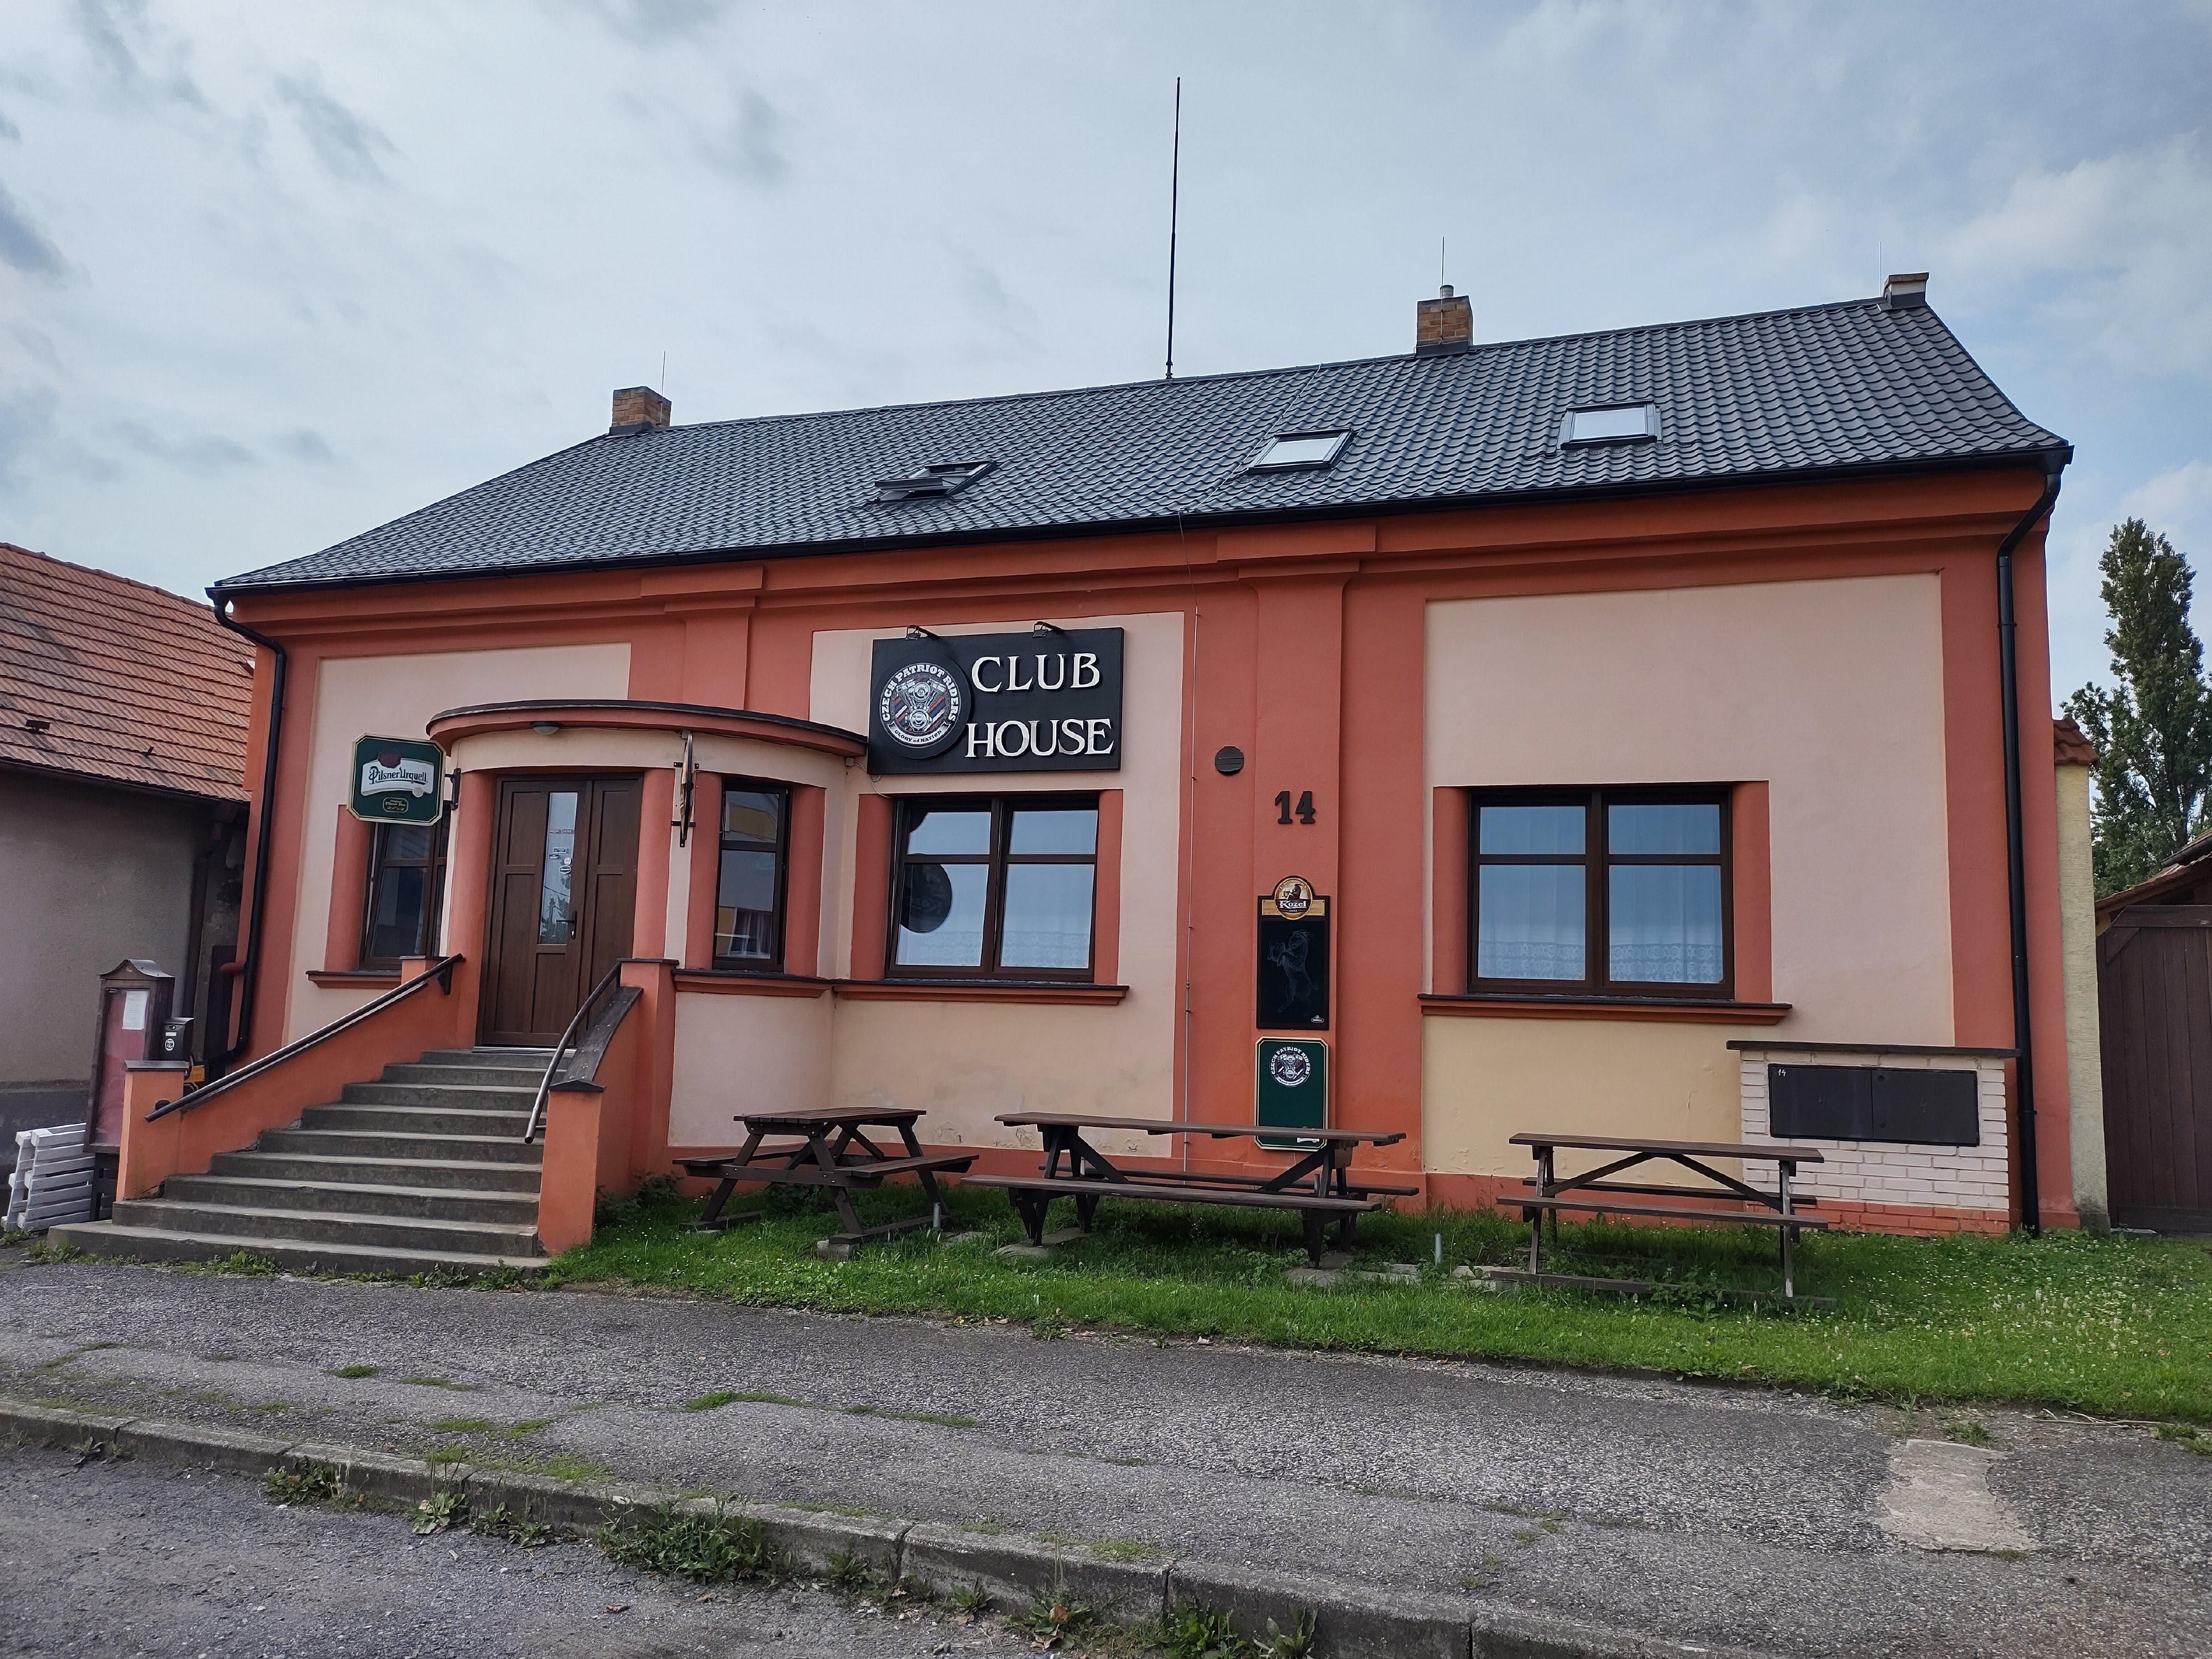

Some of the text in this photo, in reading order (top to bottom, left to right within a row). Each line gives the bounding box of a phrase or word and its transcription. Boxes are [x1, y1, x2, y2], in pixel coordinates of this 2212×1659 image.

[972, 653, 1100, 692] CLUB
[881, 664, 959, 722] CZECH PATRIOT RIDERS
[894, 729, 912, 742] GLORY
[920, 729, 942, 743] NATION
[964, 718, 1115, 758] HOUSE
[368, 766, 426, 785] Pilsner Urquell
[1275, 791, 1316, 824] 14
[1279, 900, 1307, 909] Kozel
[1276, 1046, 1302, 1055] PATRIOT
[1301, 1052, 1311, 1074] RIDERS
